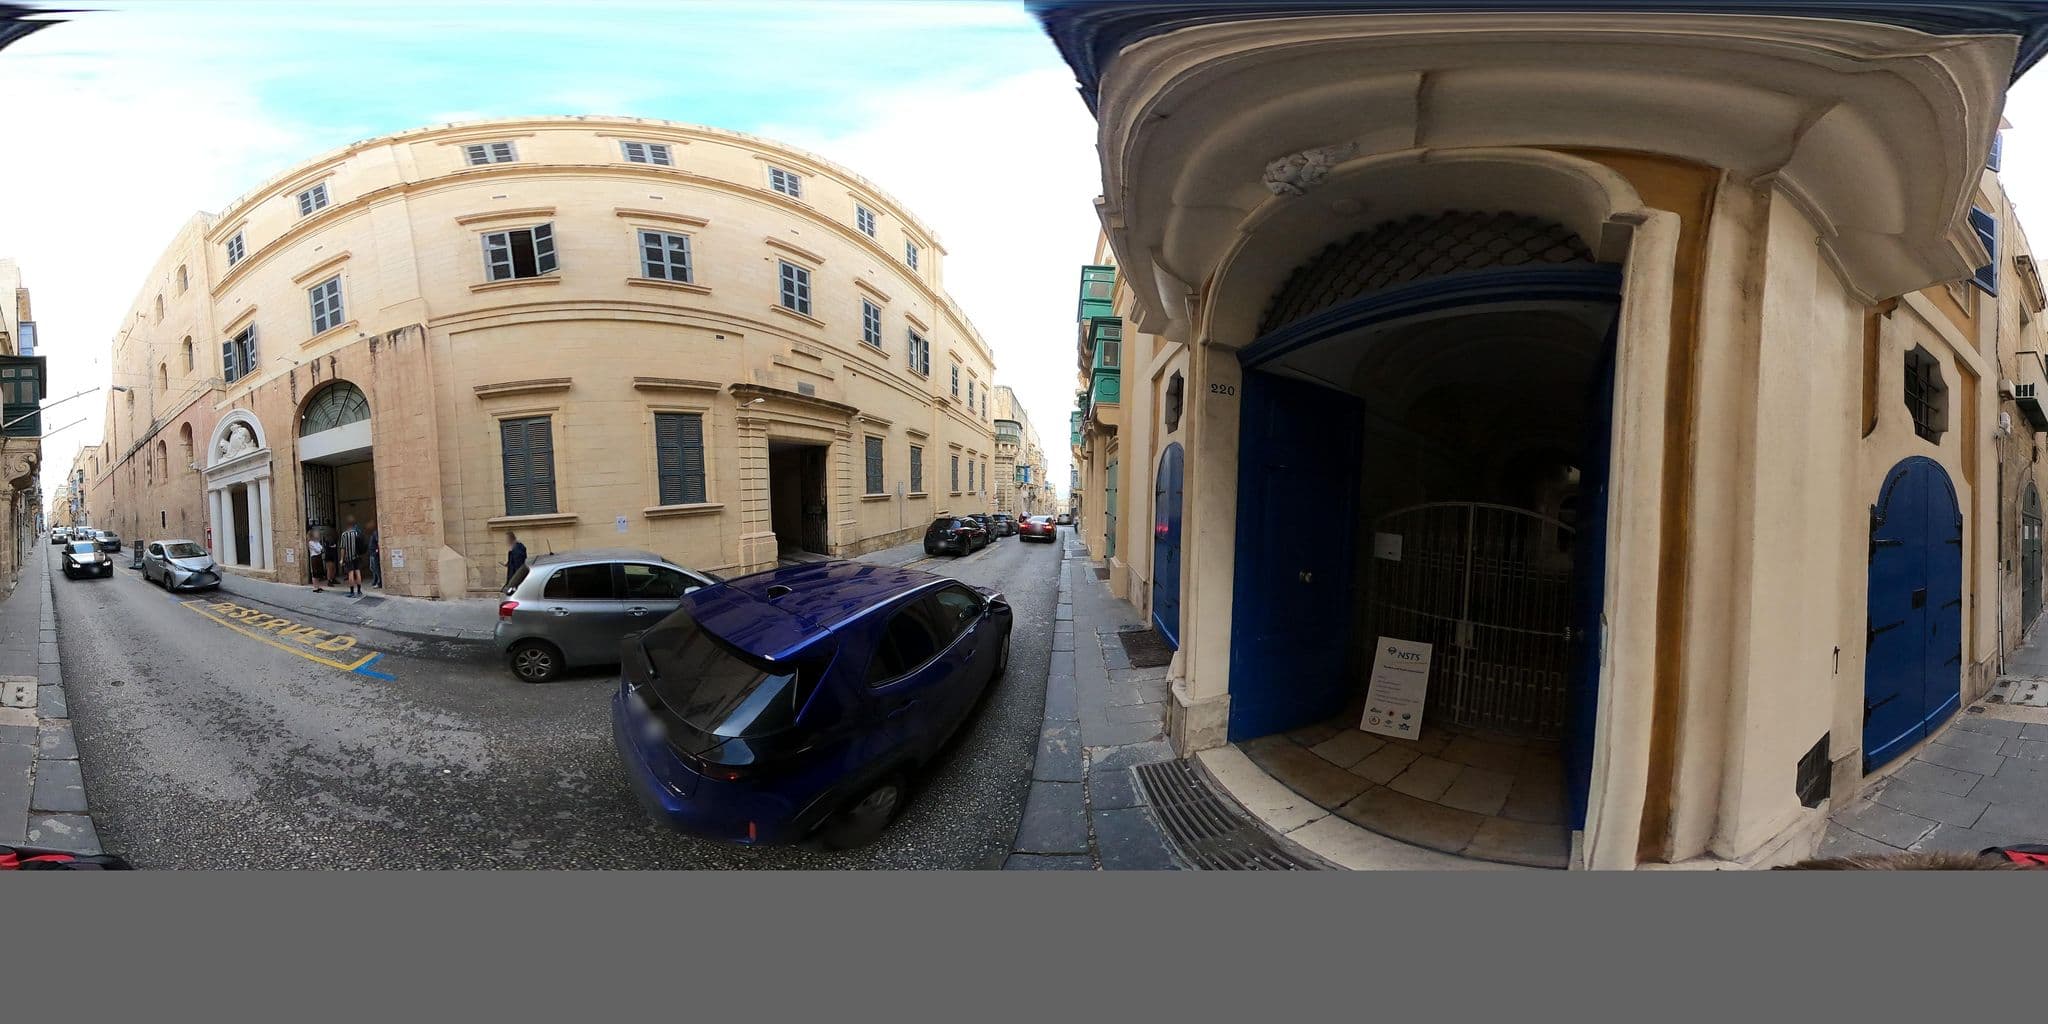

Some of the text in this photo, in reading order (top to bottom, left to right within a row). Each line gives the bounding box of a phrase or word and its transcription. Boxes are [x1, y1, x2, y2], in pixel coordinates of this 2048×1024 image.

[1211, 383, 1235, 396] 220
[207, 602, 358, 652] RESERVED
[1397, 651, 1420, 661] NSTS
